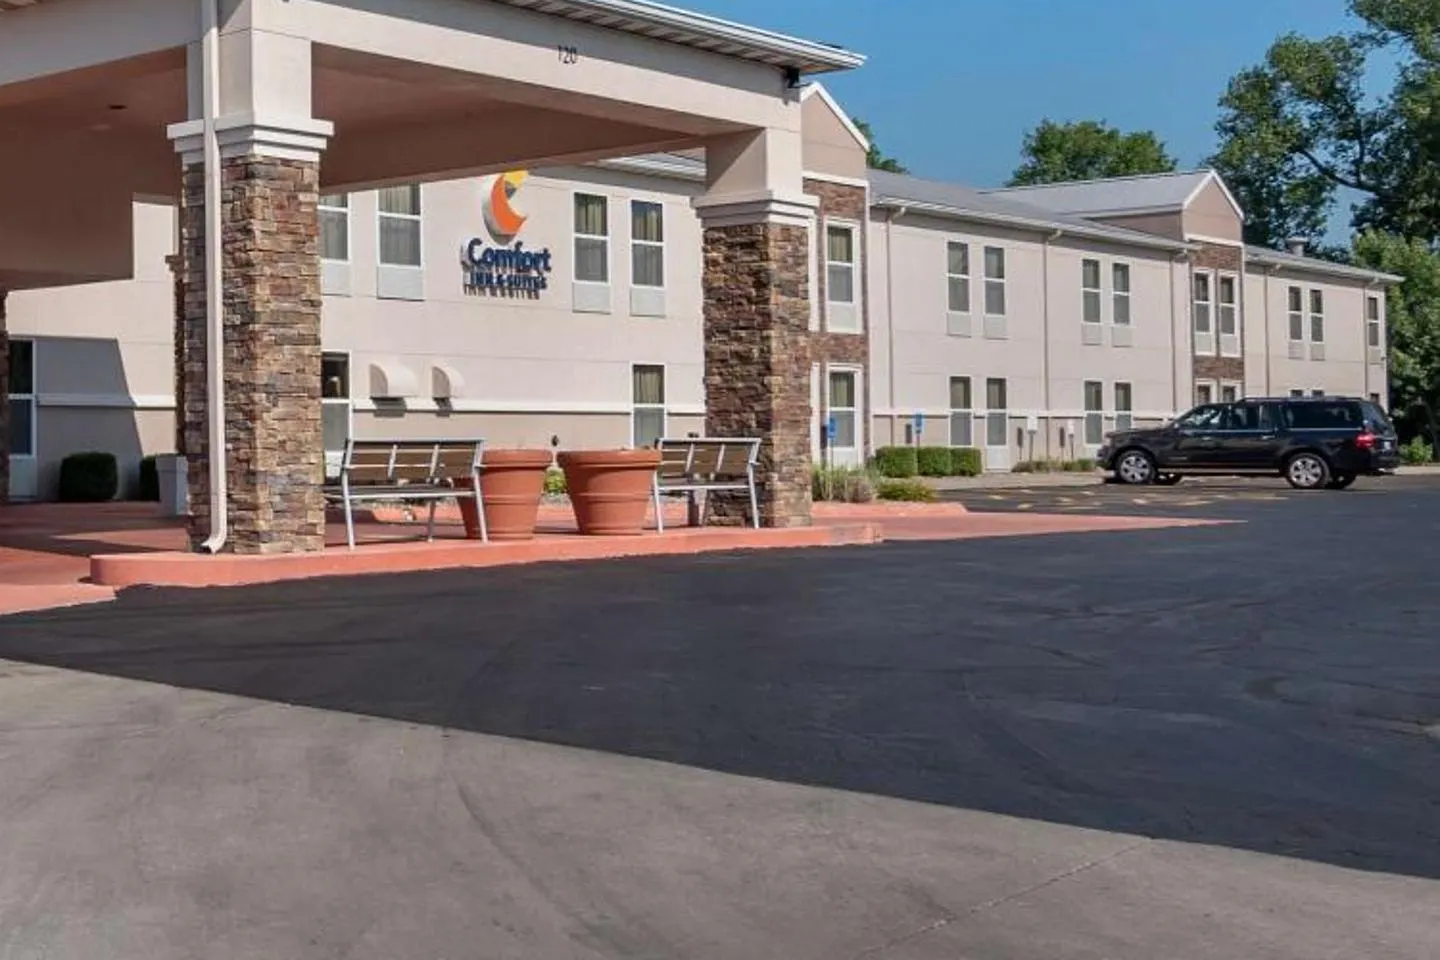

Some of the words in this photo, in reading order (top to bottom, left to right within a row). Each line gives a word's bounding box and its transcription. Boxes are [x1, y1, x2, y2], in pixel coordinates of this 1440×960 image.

[557, 45, 577, 64] 120
[468, 238, 551, 273] Comfort
[470, 271, 494, 287] INN
